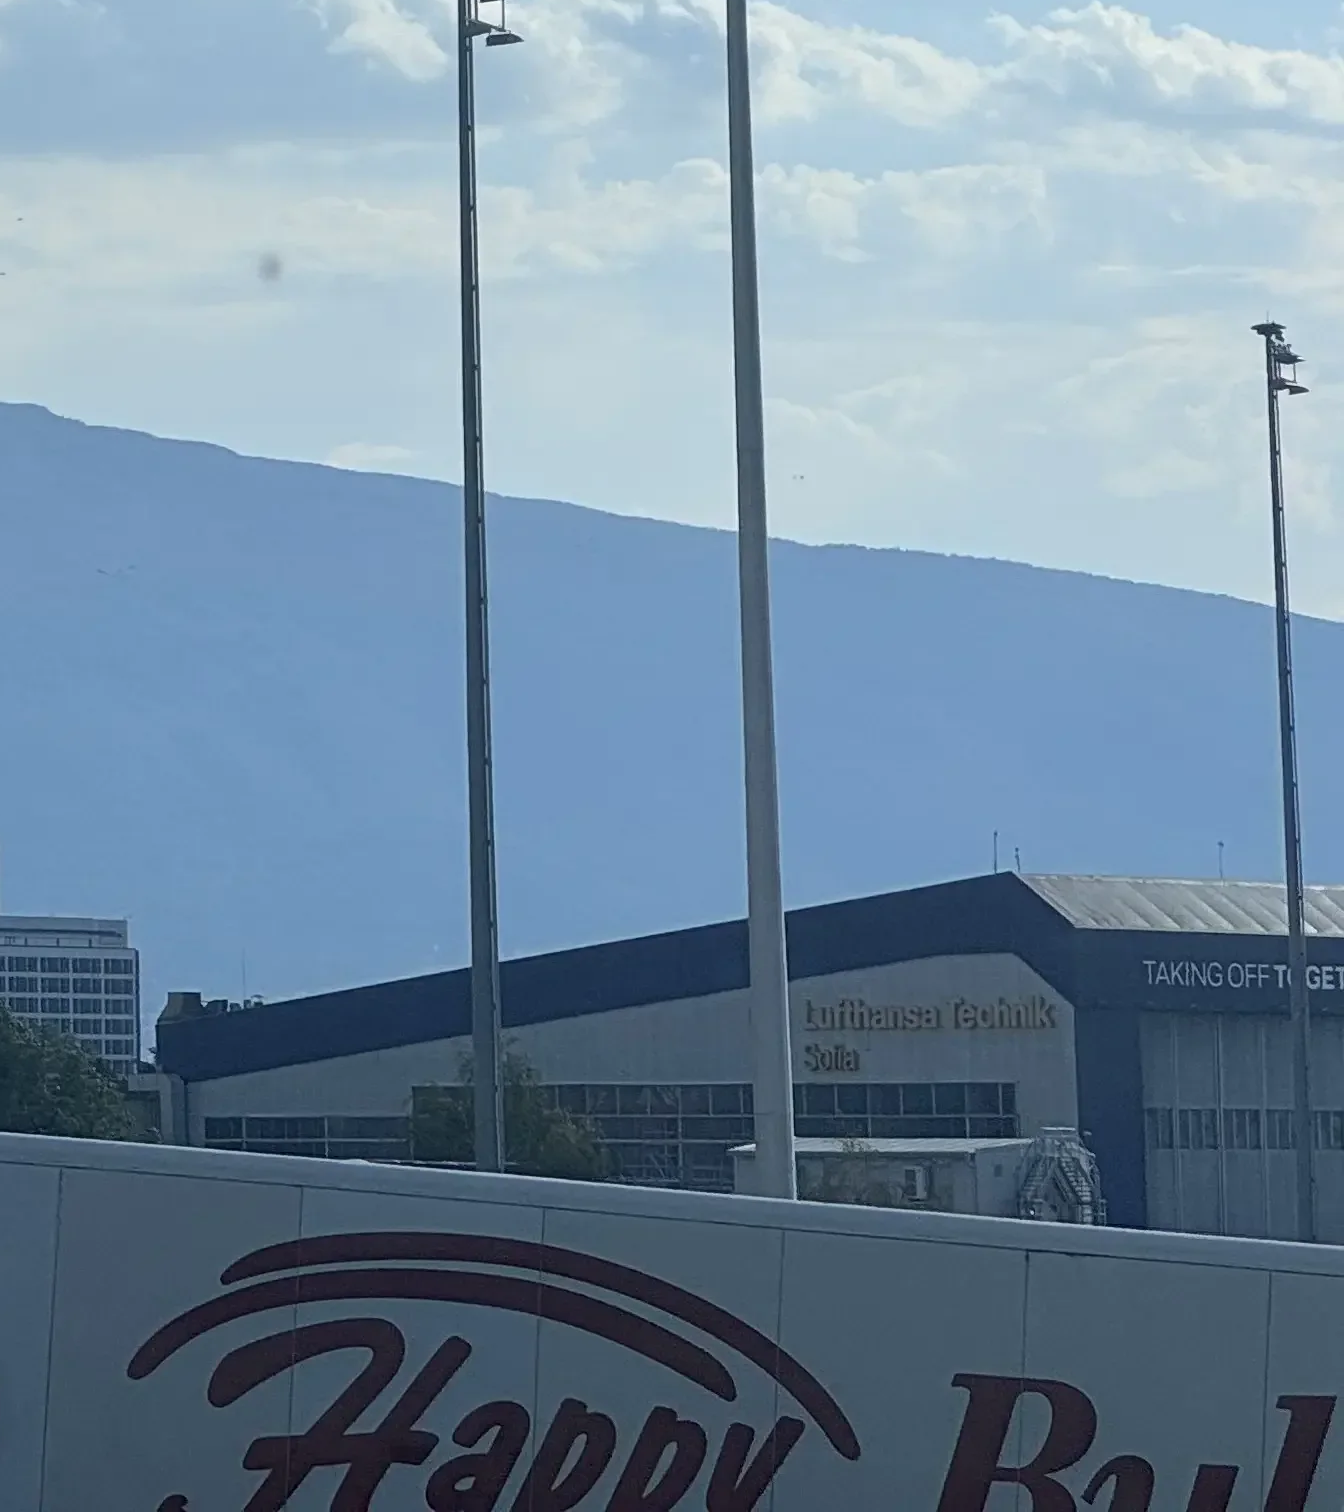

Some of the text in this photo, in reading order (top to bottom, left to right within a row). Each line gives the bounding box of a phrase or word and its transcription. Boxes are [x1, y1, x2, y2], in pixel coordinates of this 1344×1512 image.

[1142, 960, 1344, 990] TAKING OFF TGET
[803, 995, 1056, 1030] Lufthansa Technik
